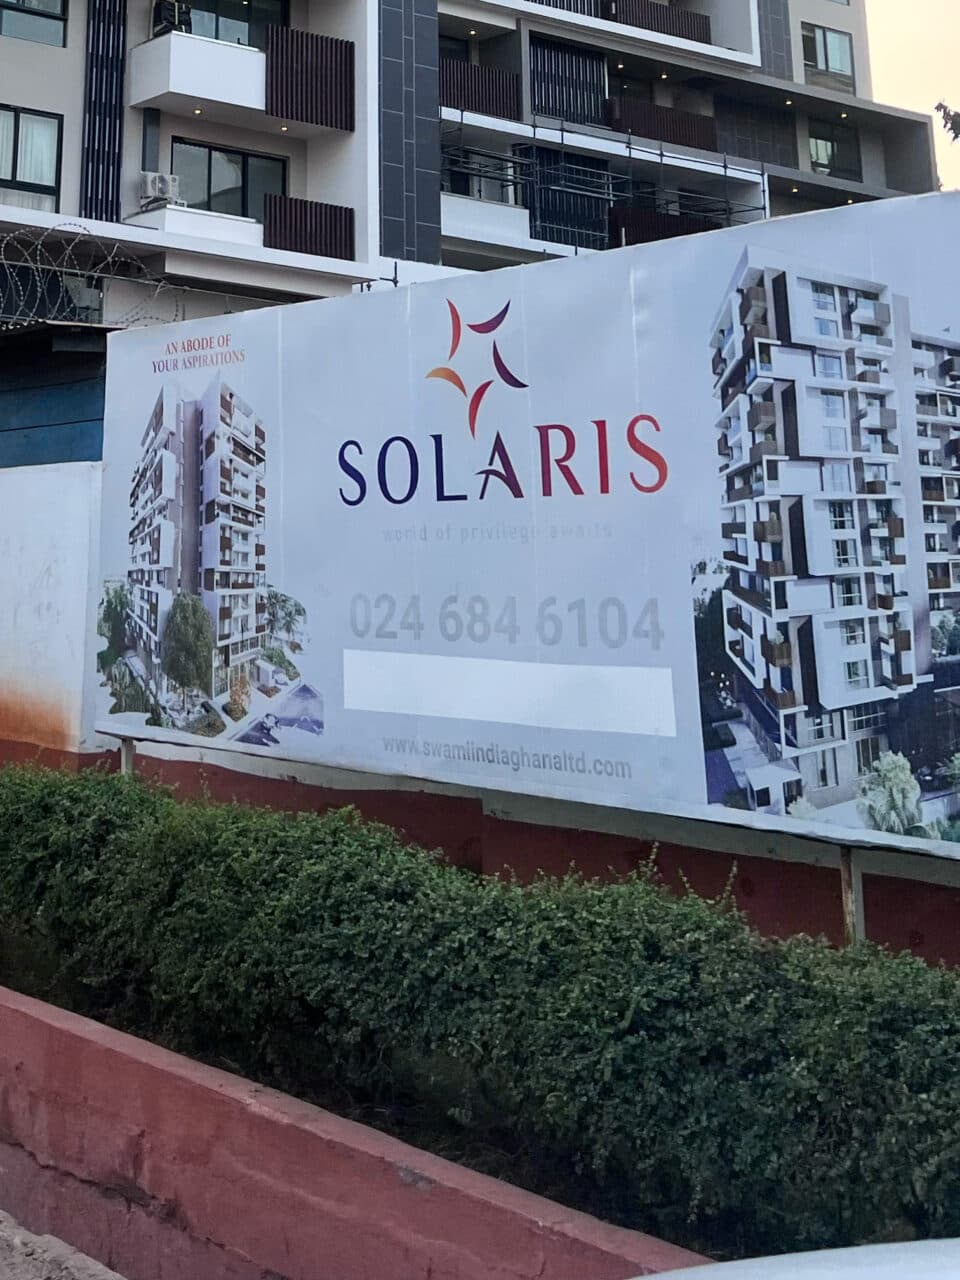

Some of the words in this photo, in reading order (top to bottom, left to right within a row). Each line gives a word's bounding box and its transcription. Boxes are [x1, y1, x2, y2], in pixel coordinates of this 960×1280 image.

[165, 342, 178, 355] AN
[181, 336, 215, 353] ABODE
[217, 334, 231, 348] OF
[152, 358, 179, 373] YOUR
[181, 350, 246, 370] ASPIRATIONS
[338, 414, 668, 506] SOLARIS
[460, 523, 537, 544] privileg
[349, 593, 424, 641] 024
[439, 594, 520, 644] 684
[537, 595, 665, 651] 6104
